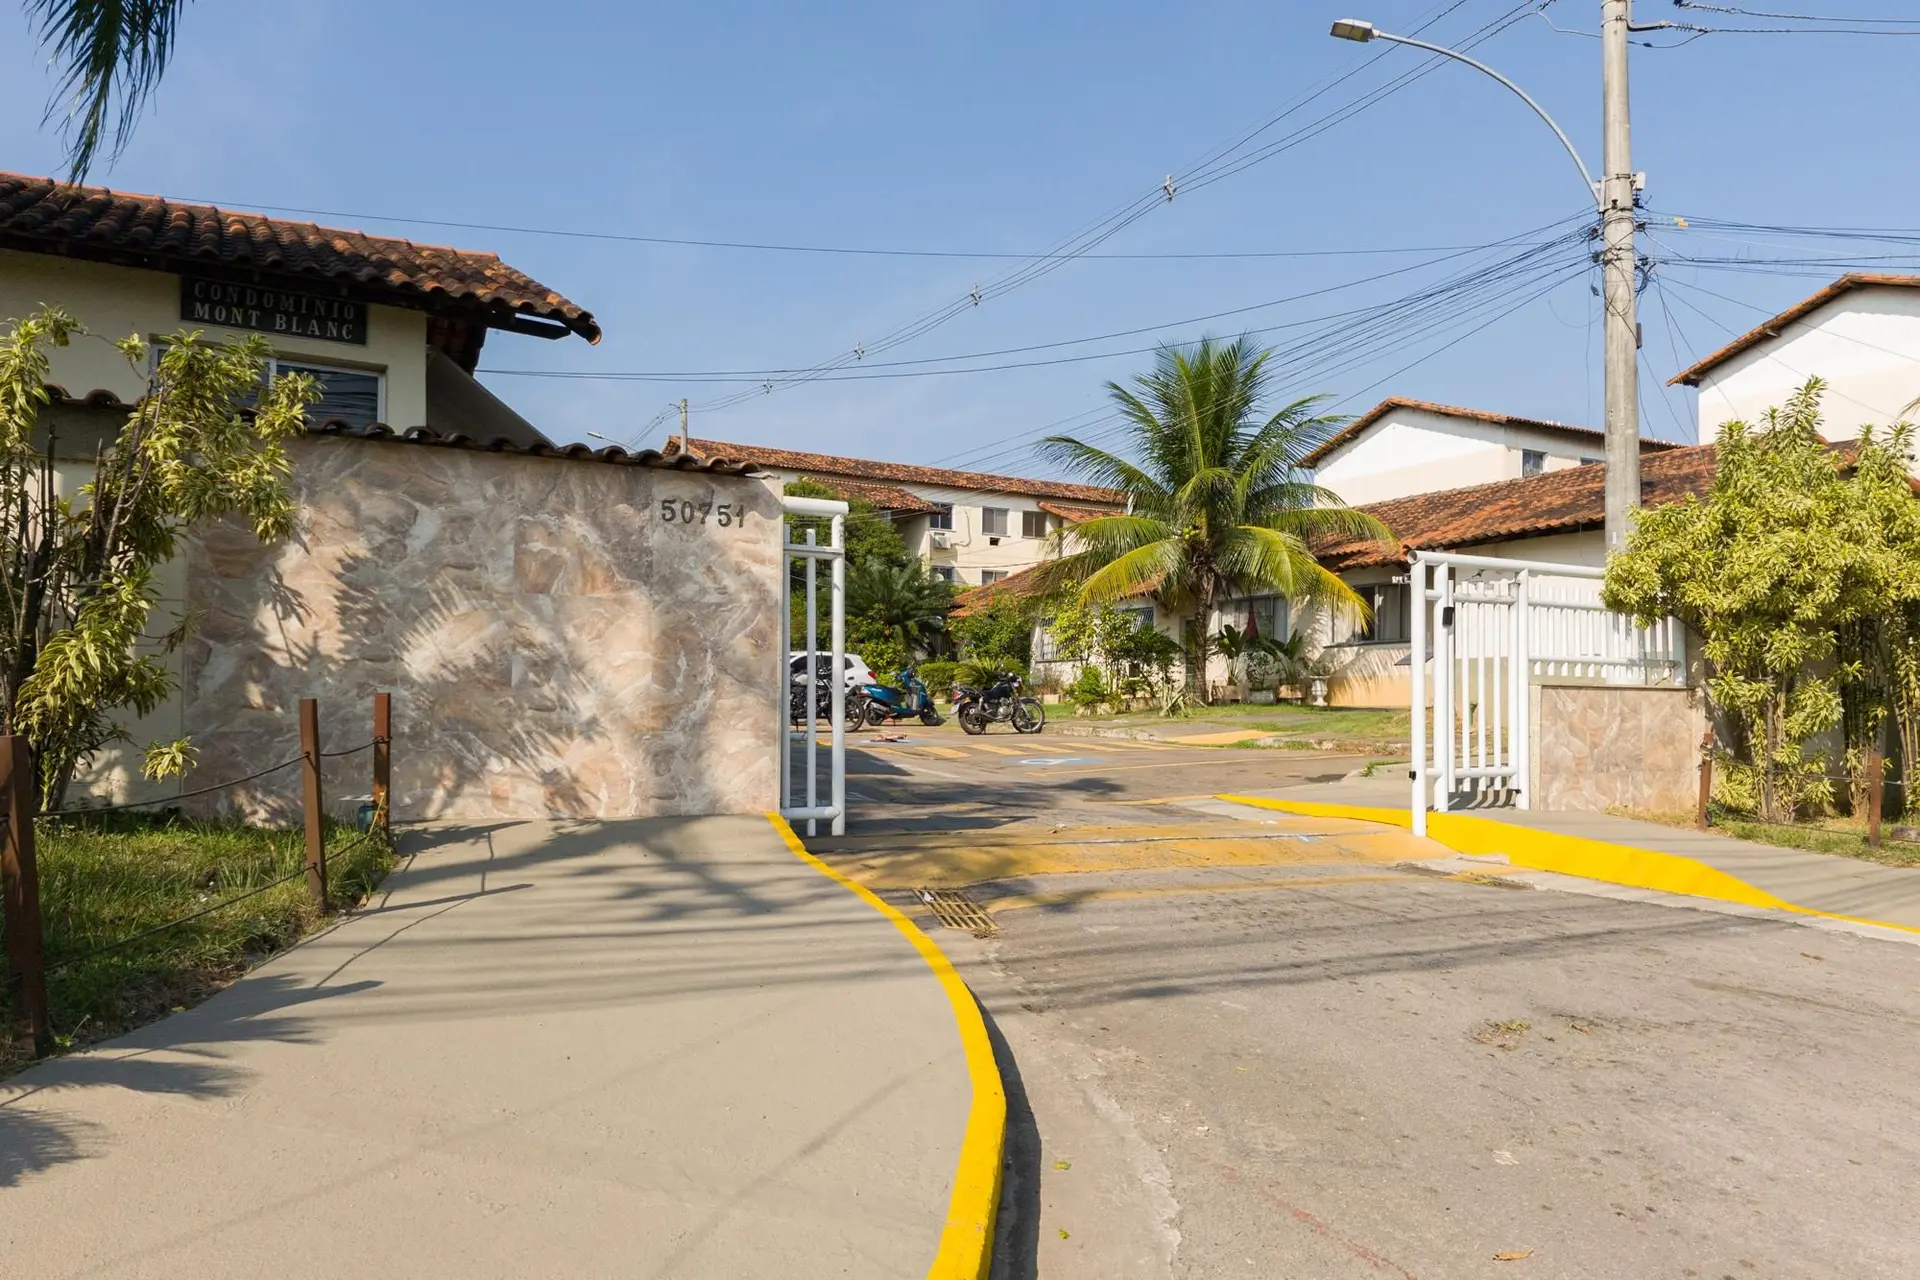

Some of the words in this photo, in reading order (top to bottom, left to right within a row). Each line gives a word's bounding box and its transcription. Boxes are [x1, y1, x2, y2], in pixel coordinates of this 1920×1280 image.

[193, 281, 356, 320] CONDOMINIO
[192, 301, 261, 328] MONT
[273, 312, 354, 340] BLANC
[661, 498, 745, 528] 50751
